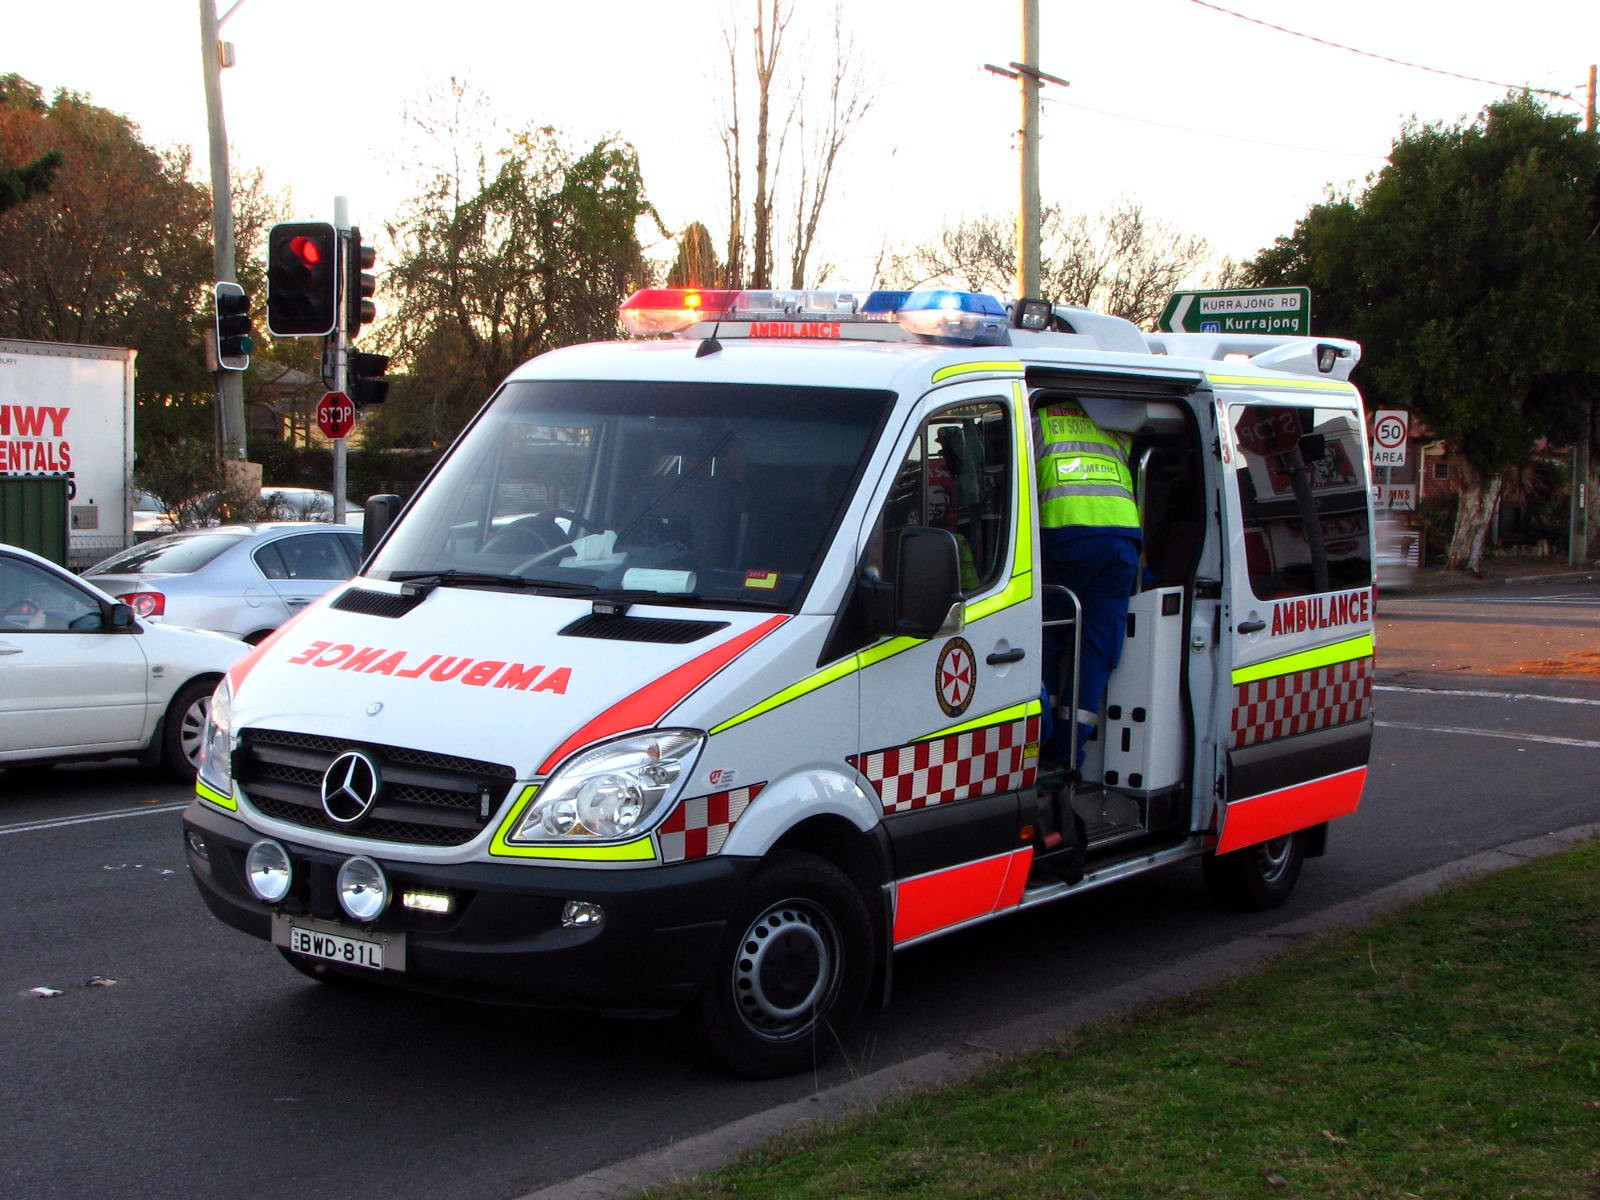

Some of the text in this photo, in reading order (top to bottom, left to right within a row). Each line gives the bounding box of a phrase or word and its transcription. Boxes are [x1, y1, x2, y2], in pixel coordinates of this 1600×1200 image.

[1203, 298, 1297, 311] KURRAJONG RD
[749, 322, 841, 338] AMBULANCE
[1225, 317, 1299, 332] Kurrajong
[320, 407, 351, 423] STOP
[1381, 425, 1401, 439] 50
[1374, 452, 1404, 462] AREA
[1271, 591, 1369, 637] AMBULANCE
